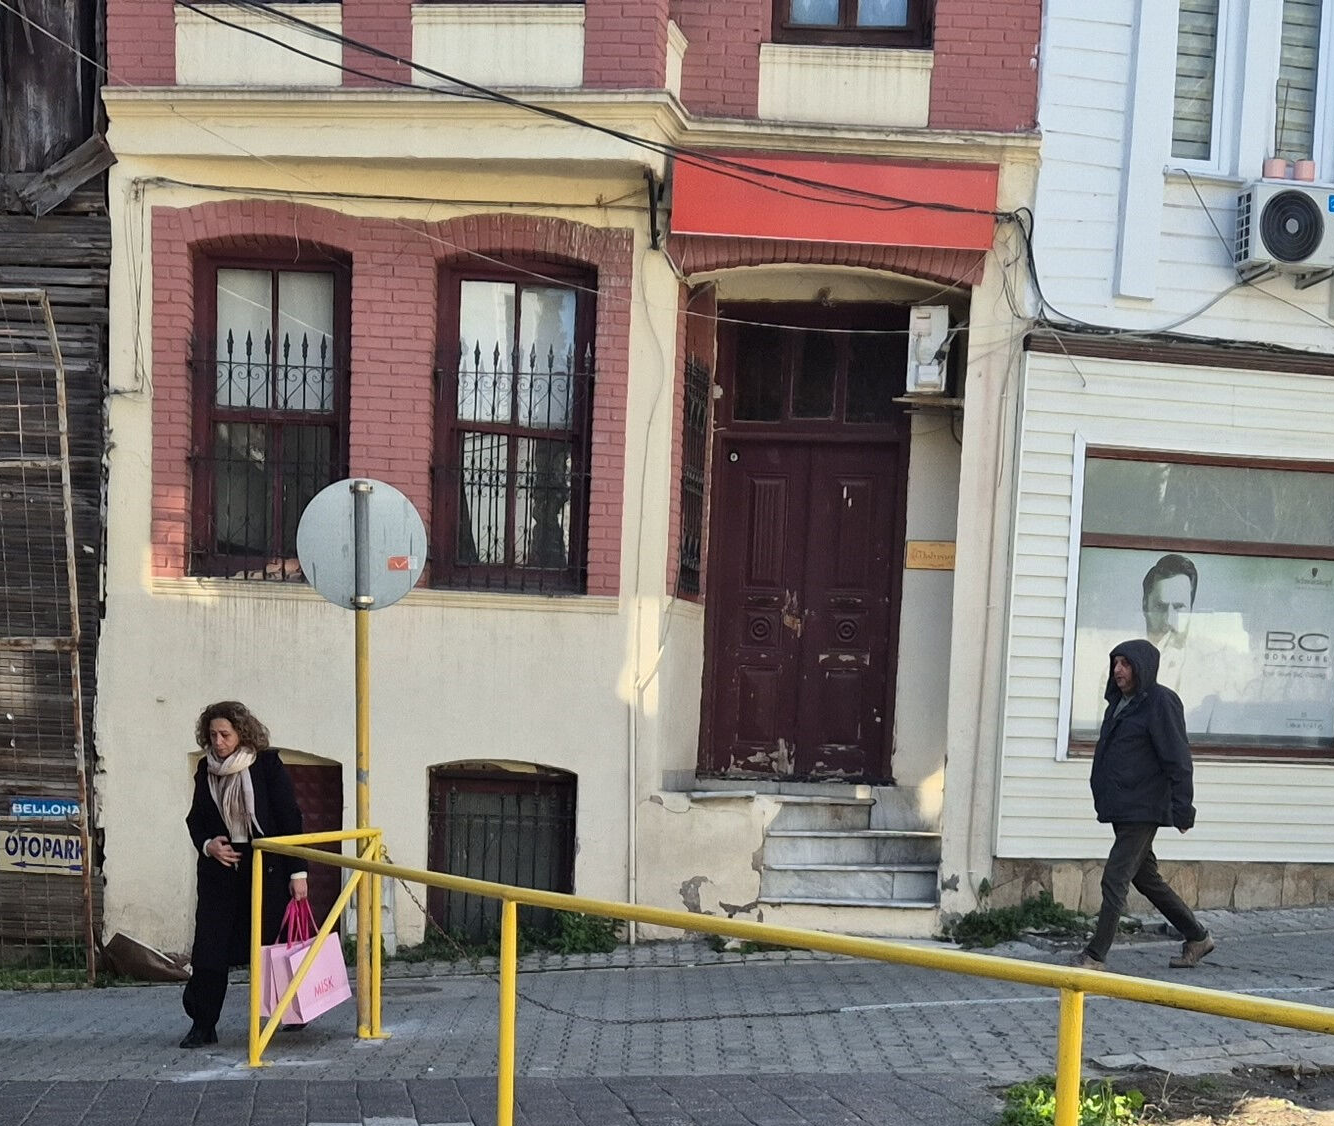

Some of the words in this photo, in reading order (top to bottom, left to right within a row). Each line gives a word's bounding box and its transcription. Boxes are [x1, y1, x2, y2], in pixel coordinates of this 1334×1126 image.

[1266, 631, 1330, 653] BC
[12, 803, 81, 815] BELLONA
[314, 975, 335, 998] MISK
